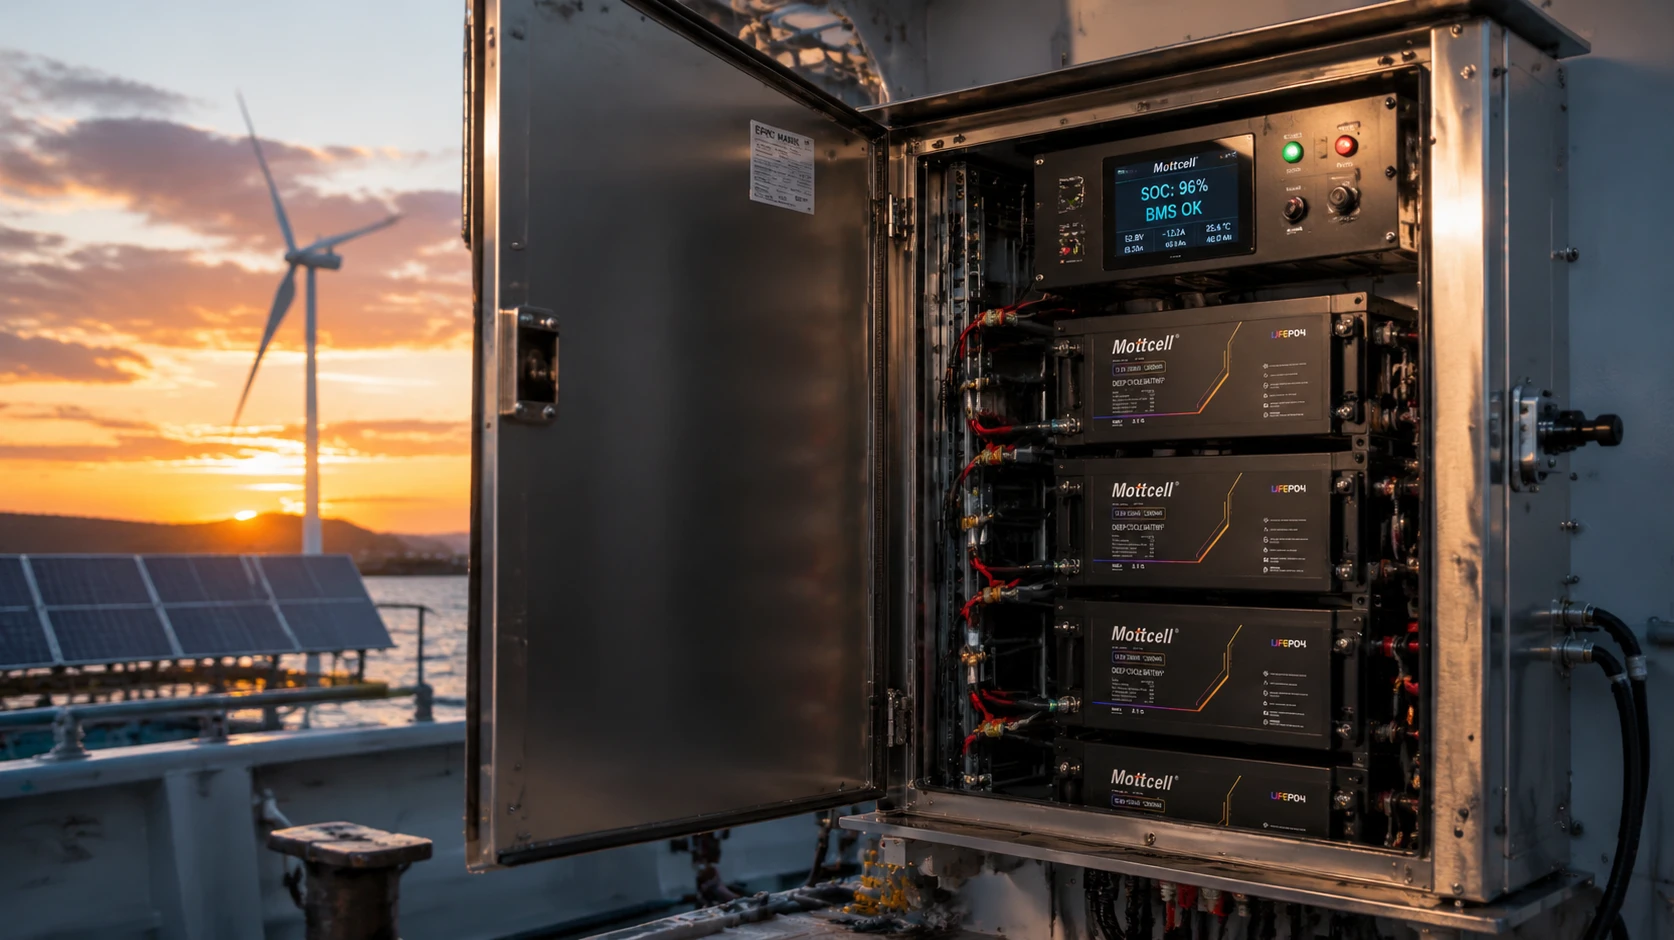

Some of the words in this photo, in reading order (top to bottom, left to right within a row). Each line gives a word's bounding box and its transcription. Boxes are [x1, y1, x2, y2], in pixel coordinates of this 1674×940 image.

[1141, 184, 1175, 201] SOC:
[1179, 178, 1208, 195] 96%
[1146, 204, 1177, 222] BMS
[1181, 201, 1202, 217] OK
